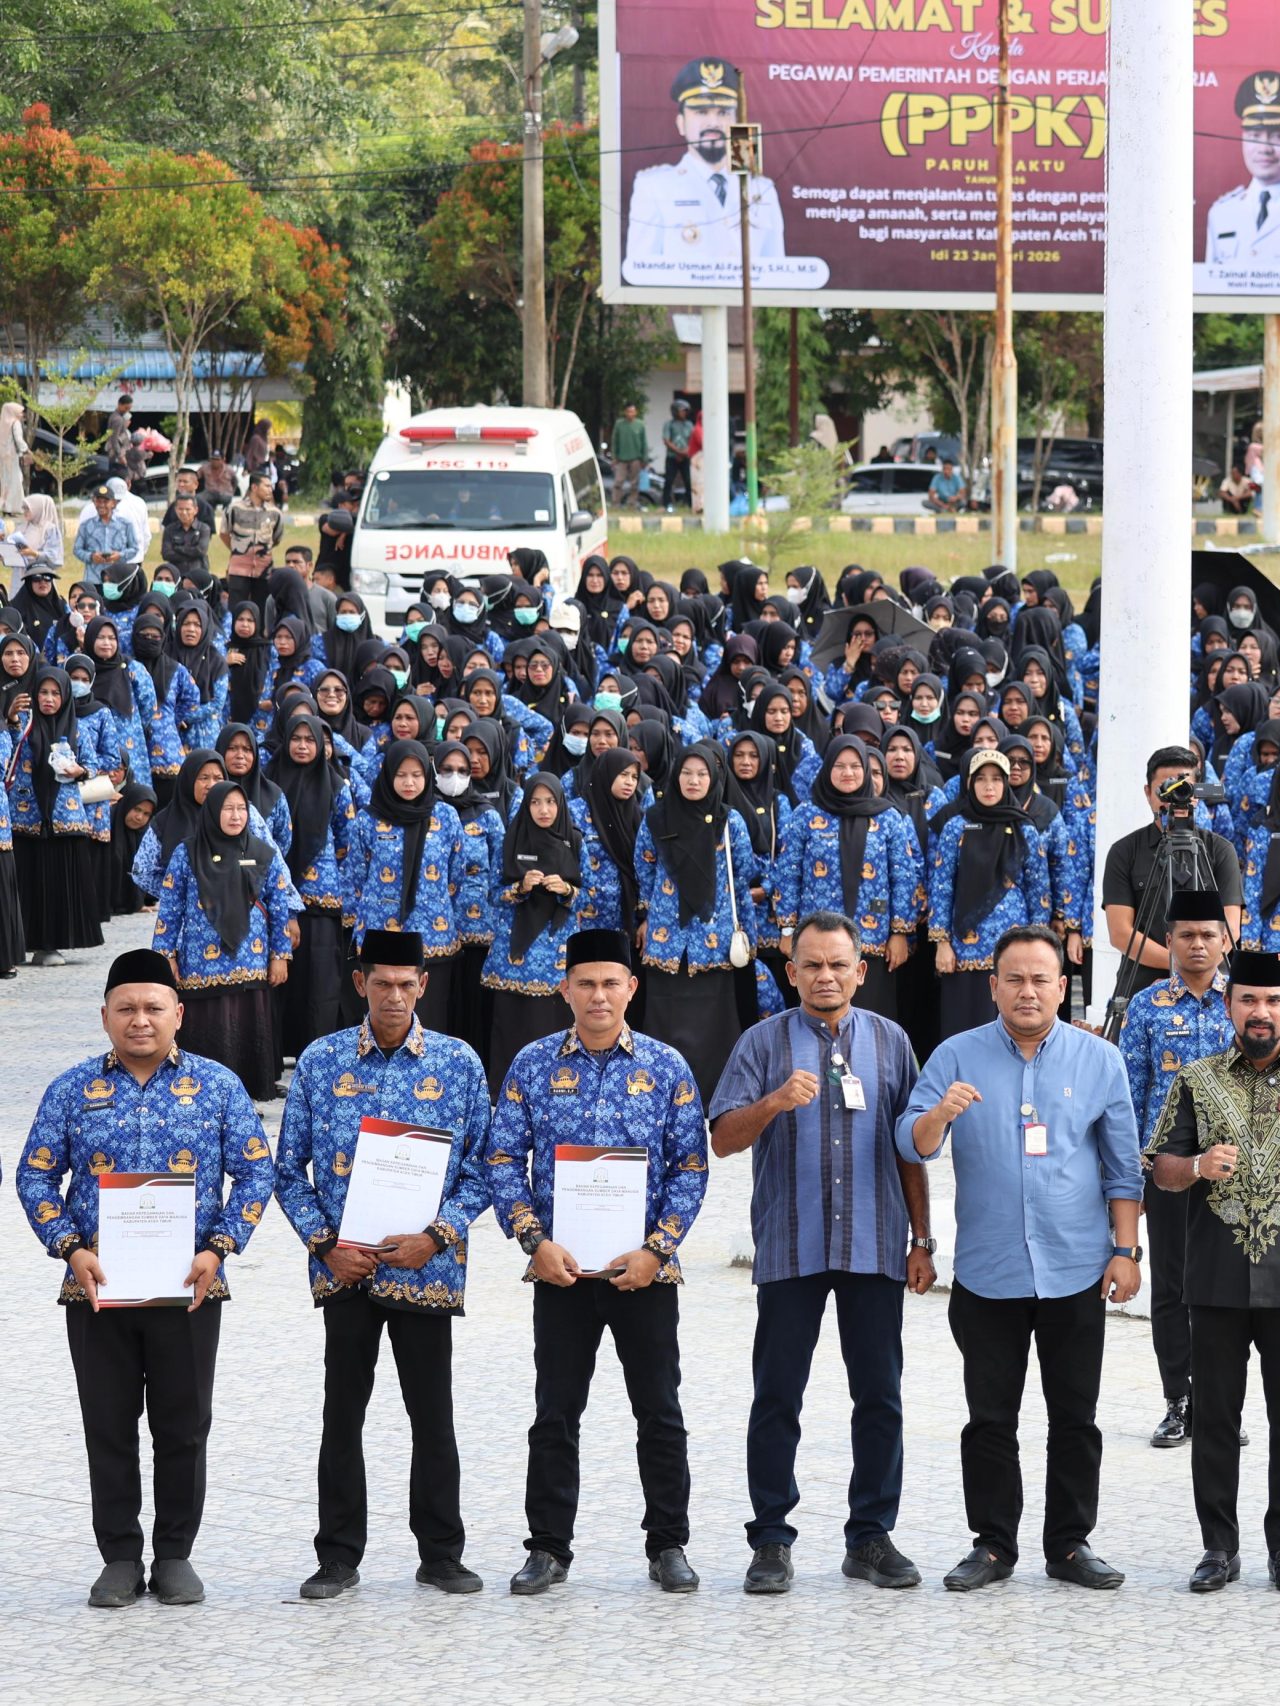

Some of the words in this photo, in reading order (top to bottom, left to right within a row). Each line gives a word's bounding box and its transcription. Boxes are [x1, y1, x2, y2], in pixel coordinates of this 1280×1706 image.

[755, 0, 984, 33] SELAMAT
[768, 64, 853, 81] PEGAWAI
[858, 67, 971, 84] PEMERINTAH
[880, 92, 1107, 160] (PPPK)
[925, 158, 989, 172] PARUH
[1014, 160, 1066, 173] AKTU
[965, 176, 997, 185] TAHUN
[792, 185, 847, 203] Semoga
[849, 186, 890, 203] dapat
[893, 188, 983, 204] menjalankan
[985, 189, 1025, 203] tuas
[1026, 189, 1077, 205] dengan
[806, 206, 865, 223] menjaga
[868, 207, 928, 222] amanah,
[931, 209, 967, 221] serta
[970, 208, 1057, 222] meerikan
[859, 225, 889, 242] bagi
[891, 227, 973, 243] masyarakat
[976, 227, 1049, 244] Kapaten
[1053, 228, 1088, 242] Aceh
[931, 249, 949, 261] Idi
[952, 251, 969, 262] 23
[972, 250, 1024, 262] Janri
[1027, 251, 1061, 263] 2026
[426, 460, 465, 469] PSC
[474, 461, 509, 469] 119
